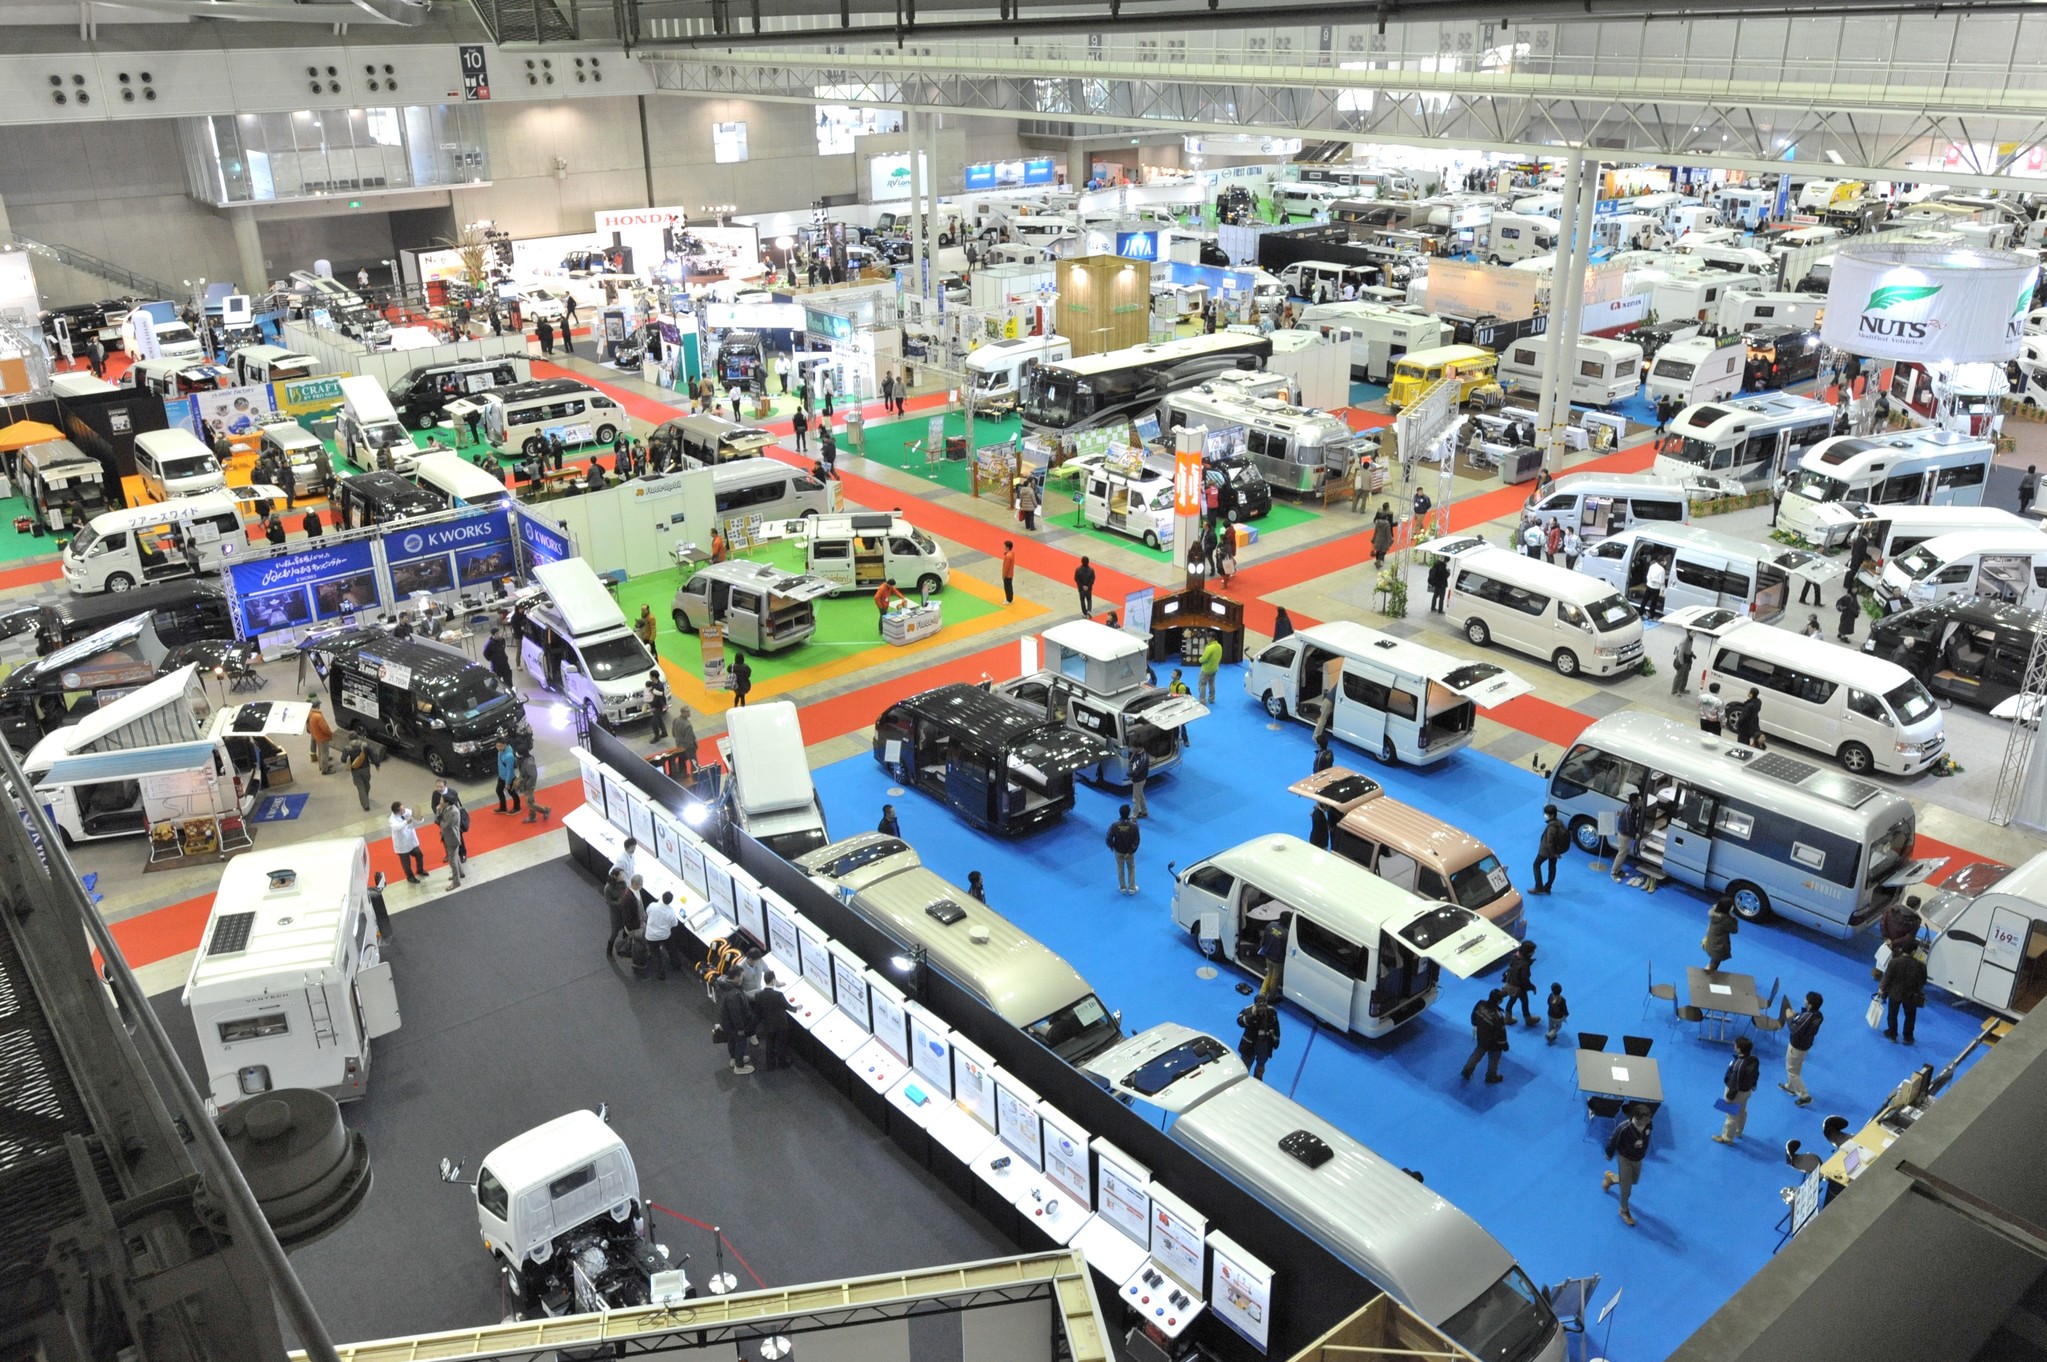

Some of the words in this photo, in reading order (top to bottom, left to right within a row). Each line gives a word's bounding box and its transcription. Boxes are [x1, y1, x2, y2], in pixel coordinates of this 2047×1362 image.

[463, 52, 482, 68] 10
[605, 213, 677, 226] HONDA
[1859, 315, 1927, 339] NUTS
[301, 383, 339, 396] CRAFT
[428, 533, 438, 546] K
[439, 522, 492, 542] WORKS
[539, 530, 563, 556] WORKS
[1994, 928, 2013, 944] 169
